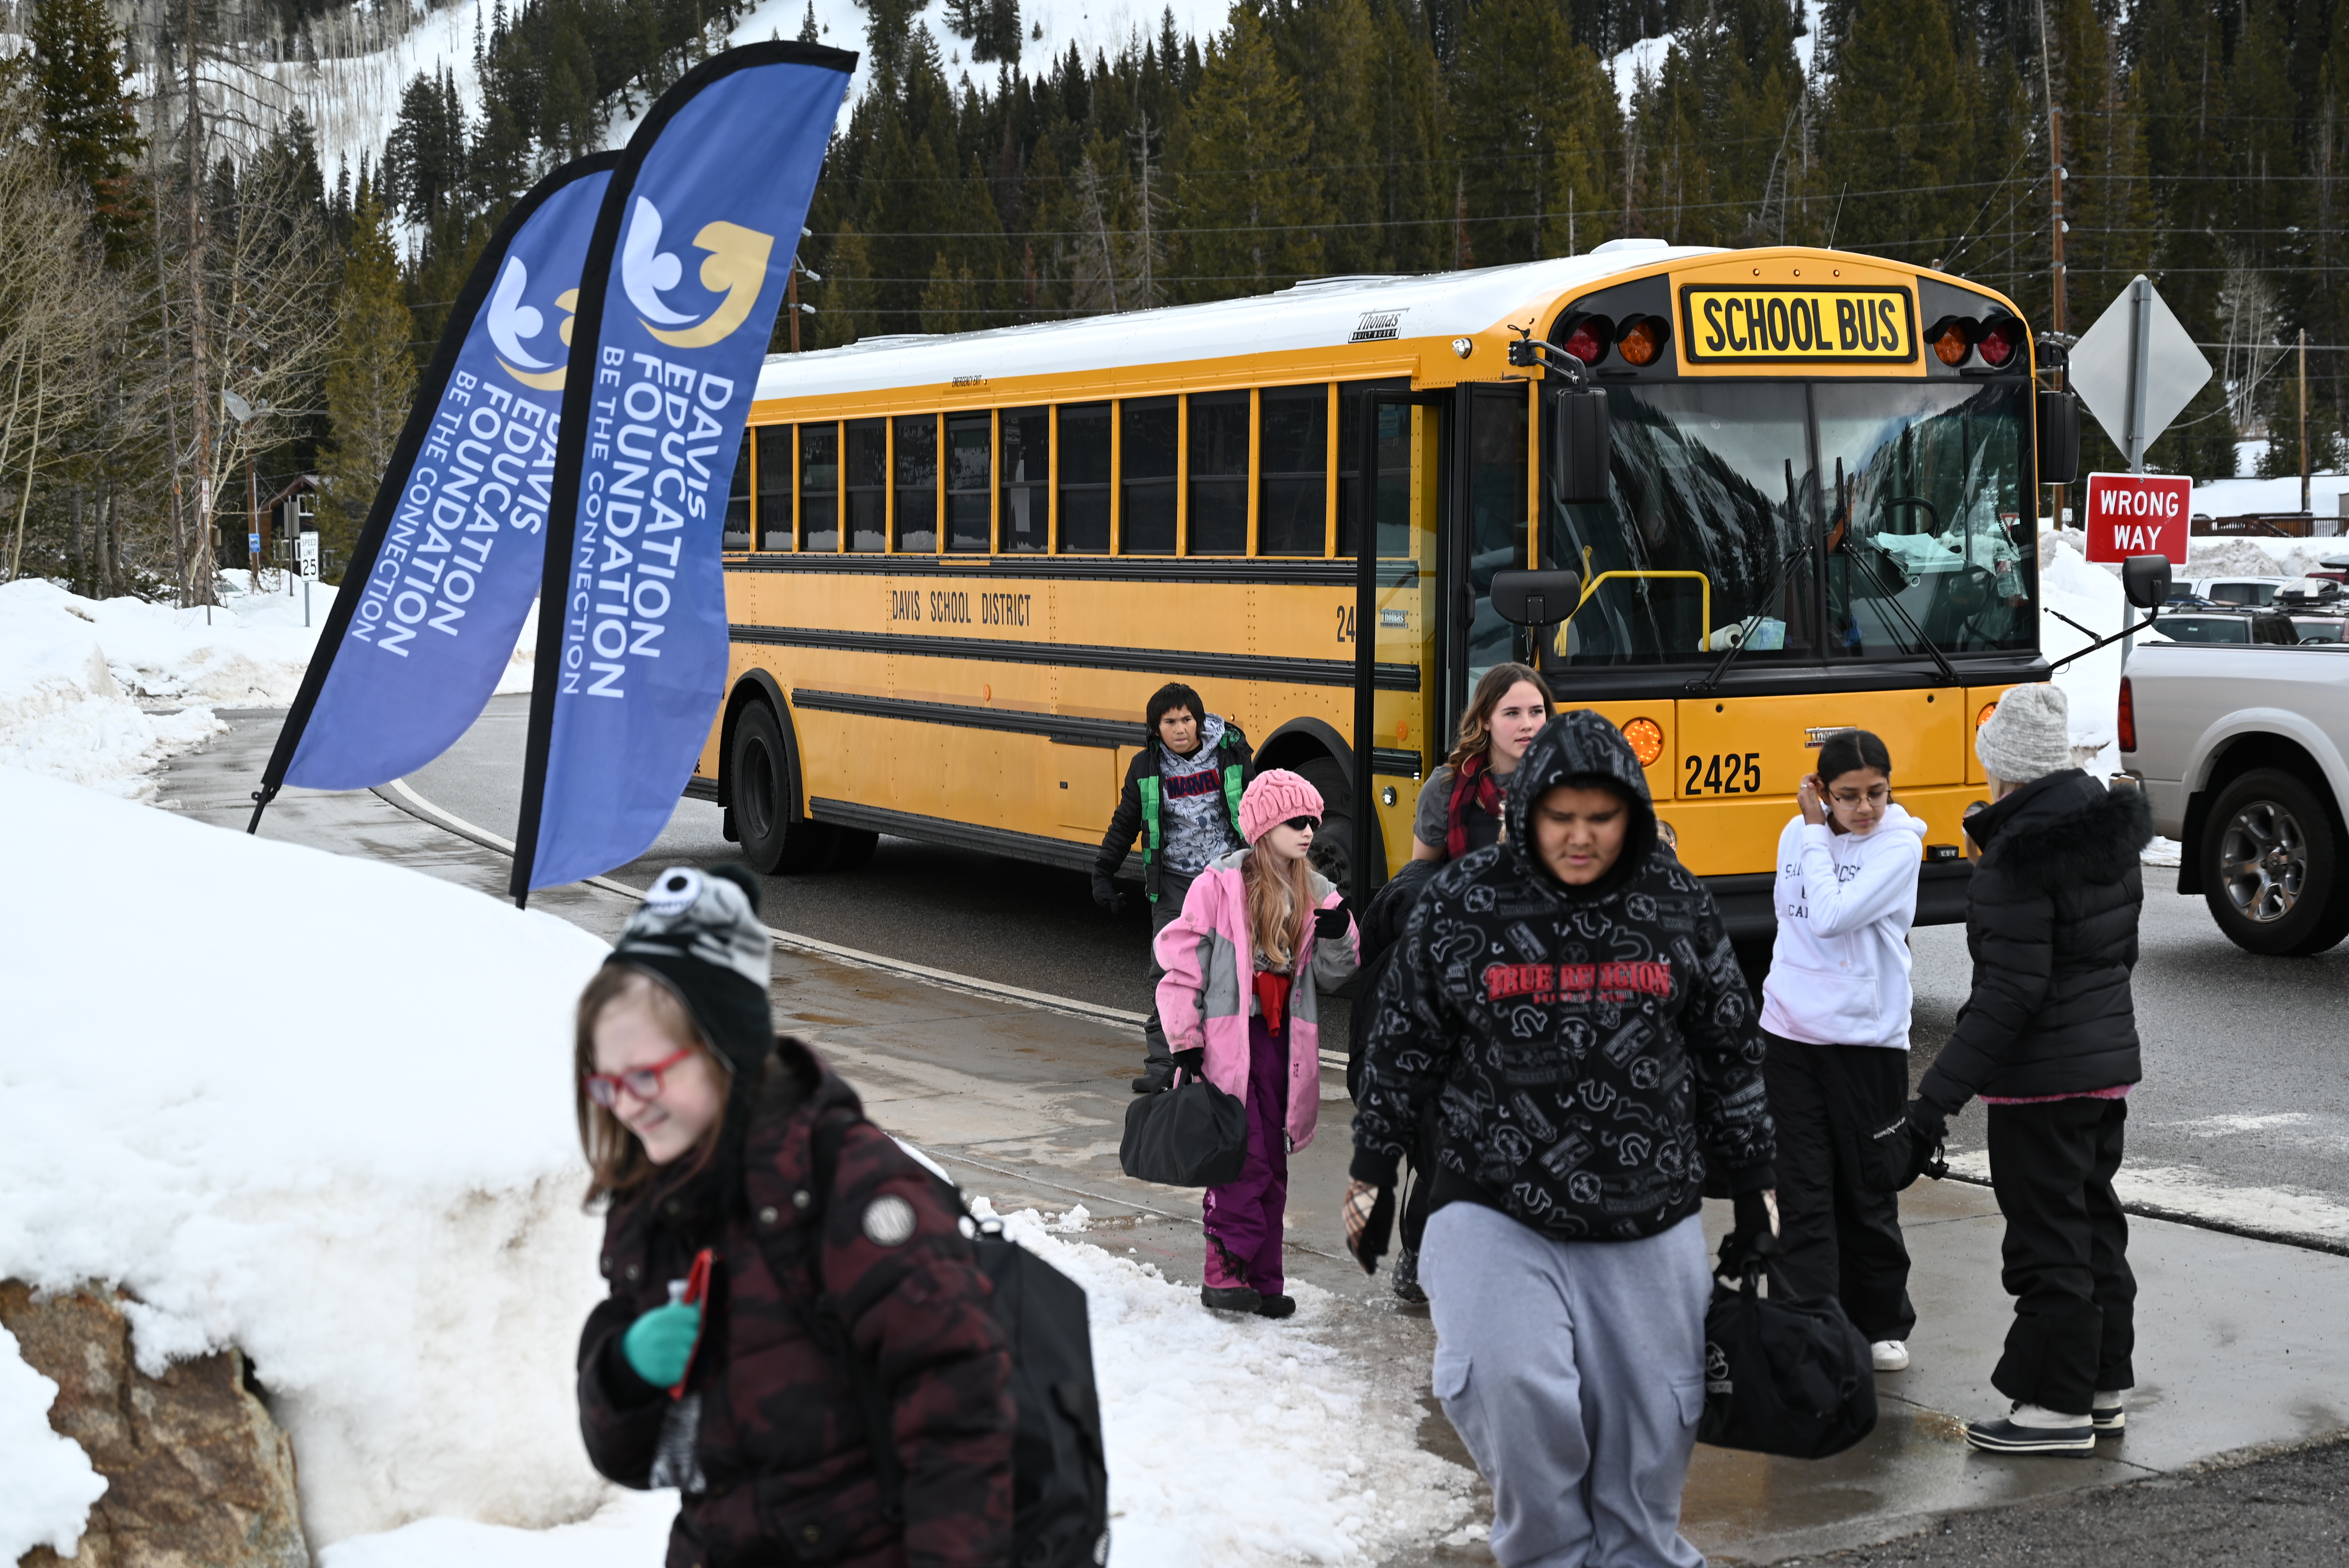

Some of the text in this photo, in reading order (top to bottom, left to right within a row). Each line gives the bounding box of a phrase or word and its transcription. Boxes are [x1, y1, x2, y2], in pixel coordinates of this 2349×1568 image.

[1357, 308, 1410, 330] Thomas
[1374, 330, 1395, 338] BUSES
[1704, 298, 1899, 351] SCHOOL BUS
[952, 375, 982, 388] EMERGENCY EXIT
[686, 372, 734, 520] DAVIS
[351, 370, 478, 643] BE THE CONNECTION
[377, 381, 513, 658] FOUNDATION
[427, 397, 547, 637] EDUCATION
[562, 346, 625, 694] BE THE CONNECTION
[628, 362, 697, 658] EDUCATION
[2101, 490, 2179, 517] WRONG
[302, 538, 317, 547] SPEED
[586, 352, 663, 698] FOUNDATION
[2114, 524, 2162, 551] WAY
[303, 548, 315, 556] LIMIT
[303, 559, 317, 576] 25
[892, 590, 1031, 626] DAVIS SCHOOL DISTRICT
[1167, 772, 1220, 798] MARVEL
[1685, 752, 1761, 796] 2425
[1486, 964, 1553, 1000] TRUE
